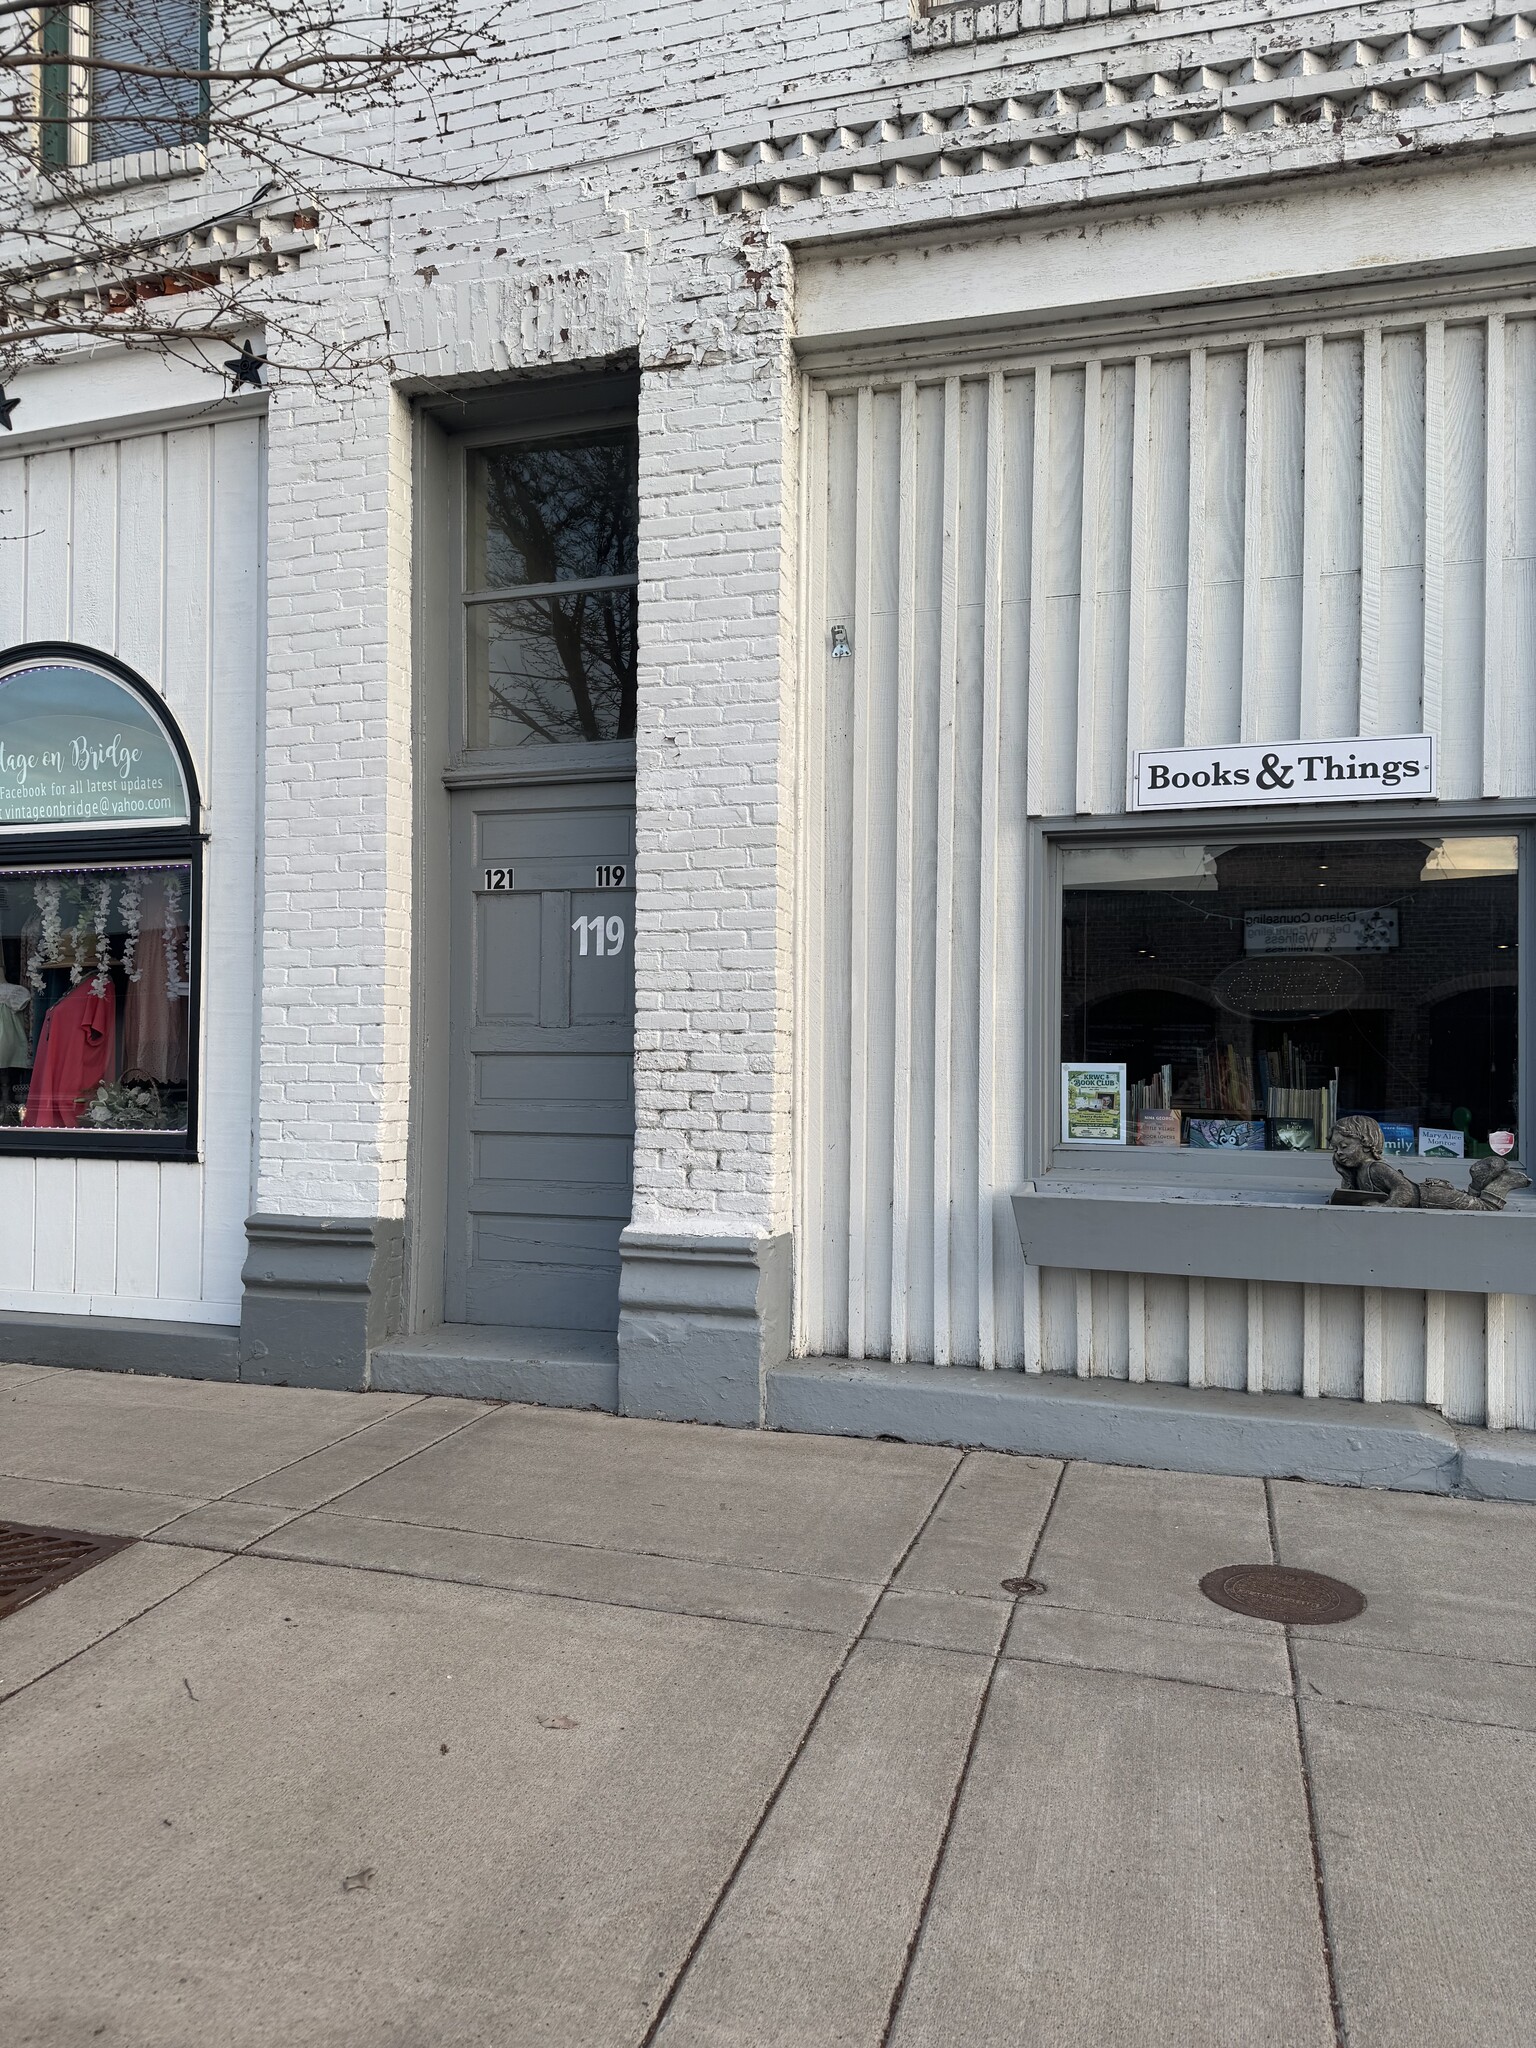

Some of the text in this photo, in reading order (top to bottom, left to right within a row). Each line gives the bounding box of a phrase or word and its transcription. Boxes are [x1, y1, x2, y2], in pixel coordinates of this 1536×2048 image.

[0, 734, 143, 784] tage on Bridge
[1147, 753, 1420, 790] Books & Things
[0, 776, 163, 799] Facebook for all latest updates
[5, 797, 171, 822] vintageonbridge@yahoo.com
[485, 869, 514, 890] 121
[596, 865, 625, 886] 119
[571, 915, 625, 956] 119
[1228, 973, 1343, 999] OPEN
[1385, 1138, 1413, 1152] mily
[1422, 1131, 1442, 1139] Mary
[1428, 1138, 1457, 1147] Monroe
